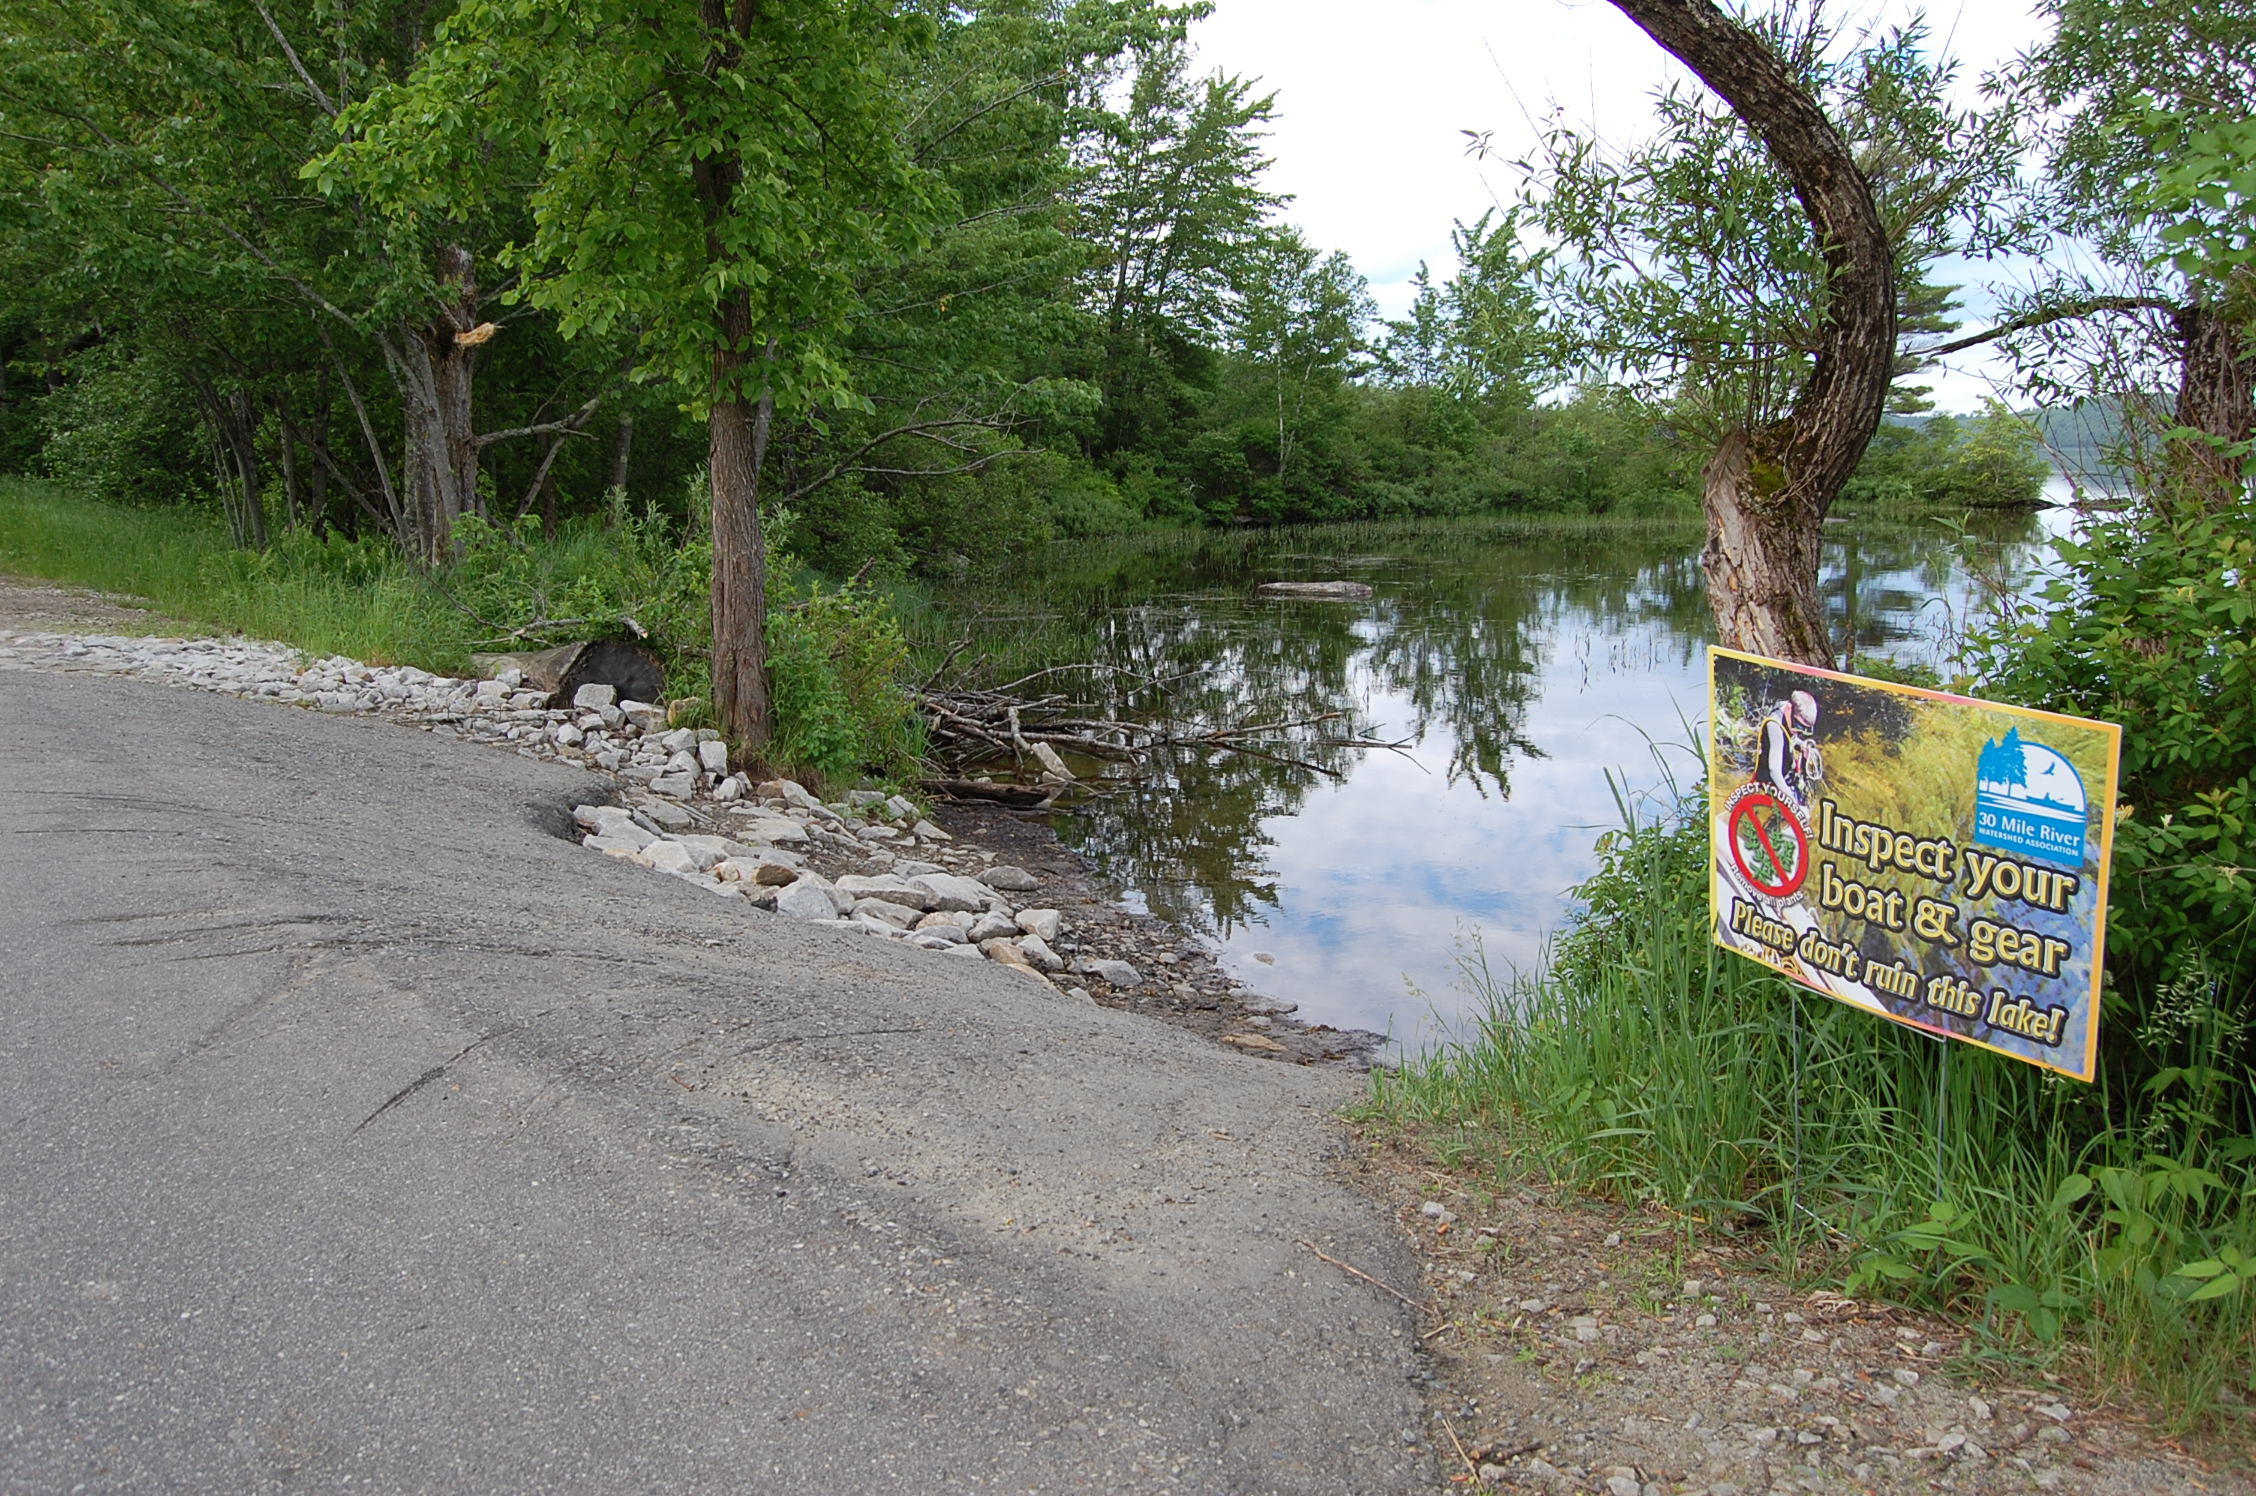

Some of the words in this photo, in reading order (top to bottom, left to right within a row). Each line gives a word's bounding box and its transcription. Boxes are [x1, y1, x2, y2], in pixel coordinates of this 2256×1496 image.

[1724, 781, 1760, 812] INSPECT
[1762, 782, 1815, 841] YOURSELF!
[1978, 811, 1996, 827] 30
[2001, 816, 2035, 837] Mile
[2040, 824, 2081, 847] River
[1821, 801, 1953, 879] Inspect
[1966, 848, 2076, 911] your
[1978, 827, 2023, 844] WATERSHED
[2025, 838, 2079, 857] ASSOCIATION
[1731, 864, 1763, 902] Remove
[1821, 864, 1904, 928] boat
[1914, 901, 1959, 945] &
[1969, 920, 2068, 976] gear
[1732, 900, 1794, 951] Please
[1801, 928, 1859, 978] don't
[1865, 960, 1917, 1000] ruin
[1927, 975, 1979, 1017] this
[1987, 990, 2066, 1042] lake!
